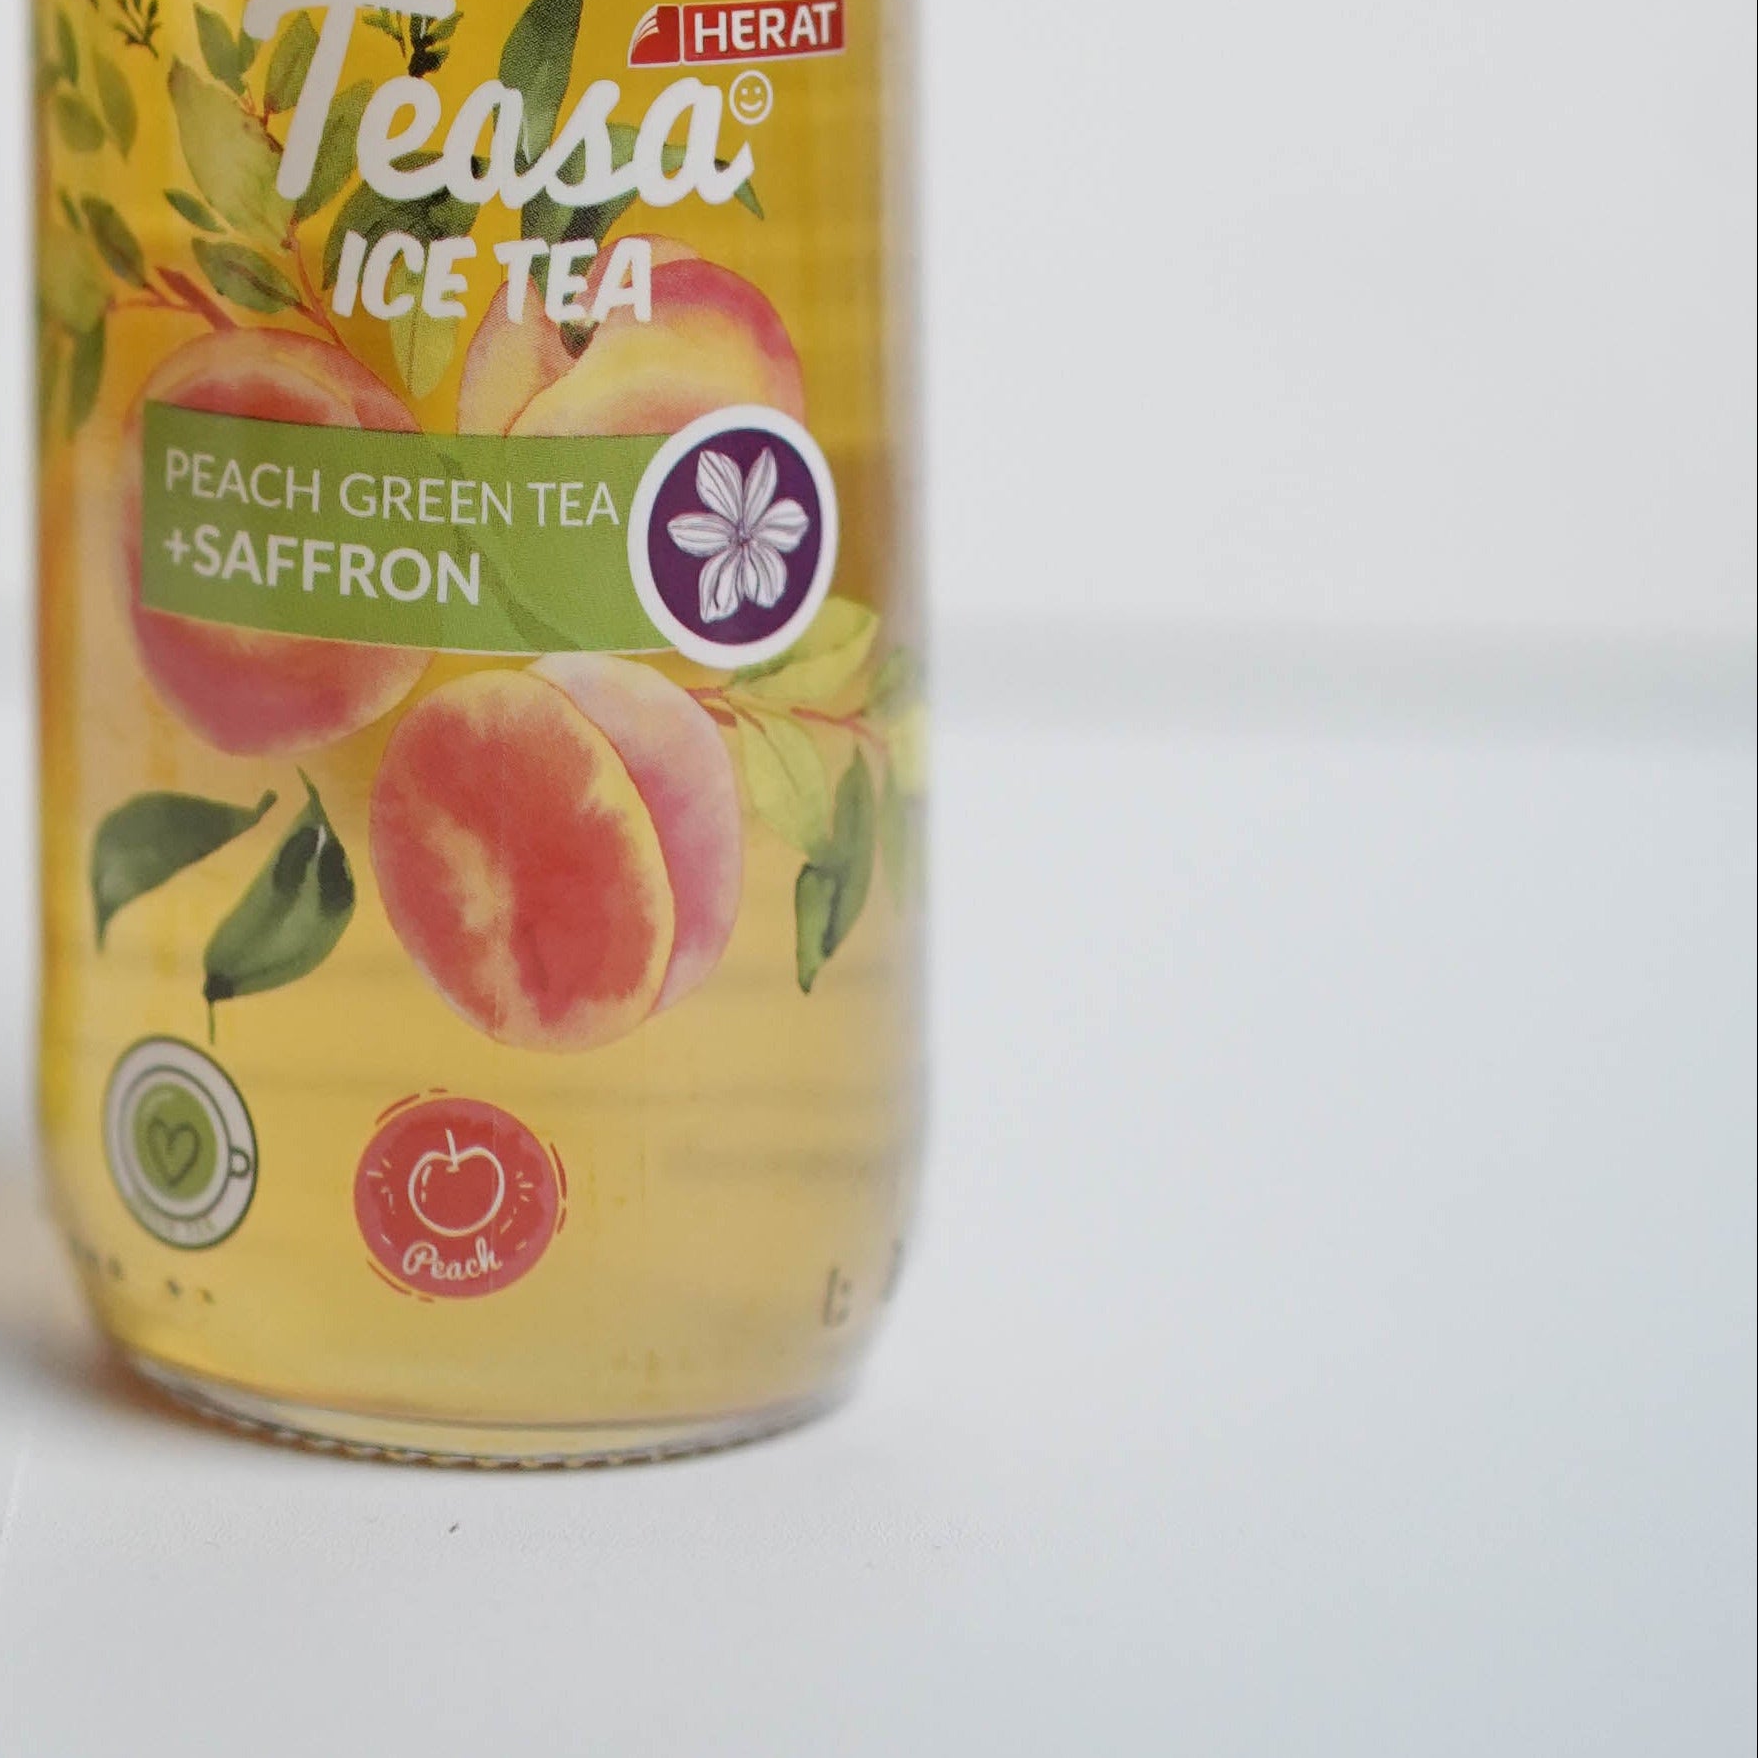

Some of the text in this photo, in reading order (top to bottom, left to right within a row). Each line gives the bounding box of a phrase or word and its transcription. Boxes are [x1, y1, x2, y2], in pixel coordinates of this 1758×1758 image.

[693, 0, 839, 56] HERAT
[332, 229, 653, 324] ICE TEA
[164, 447, 621, 528] PEACH GREEN TEA
[163, 523, 481, 606] +SAFFRON
[402, 1235, 504, 1282] Peach
